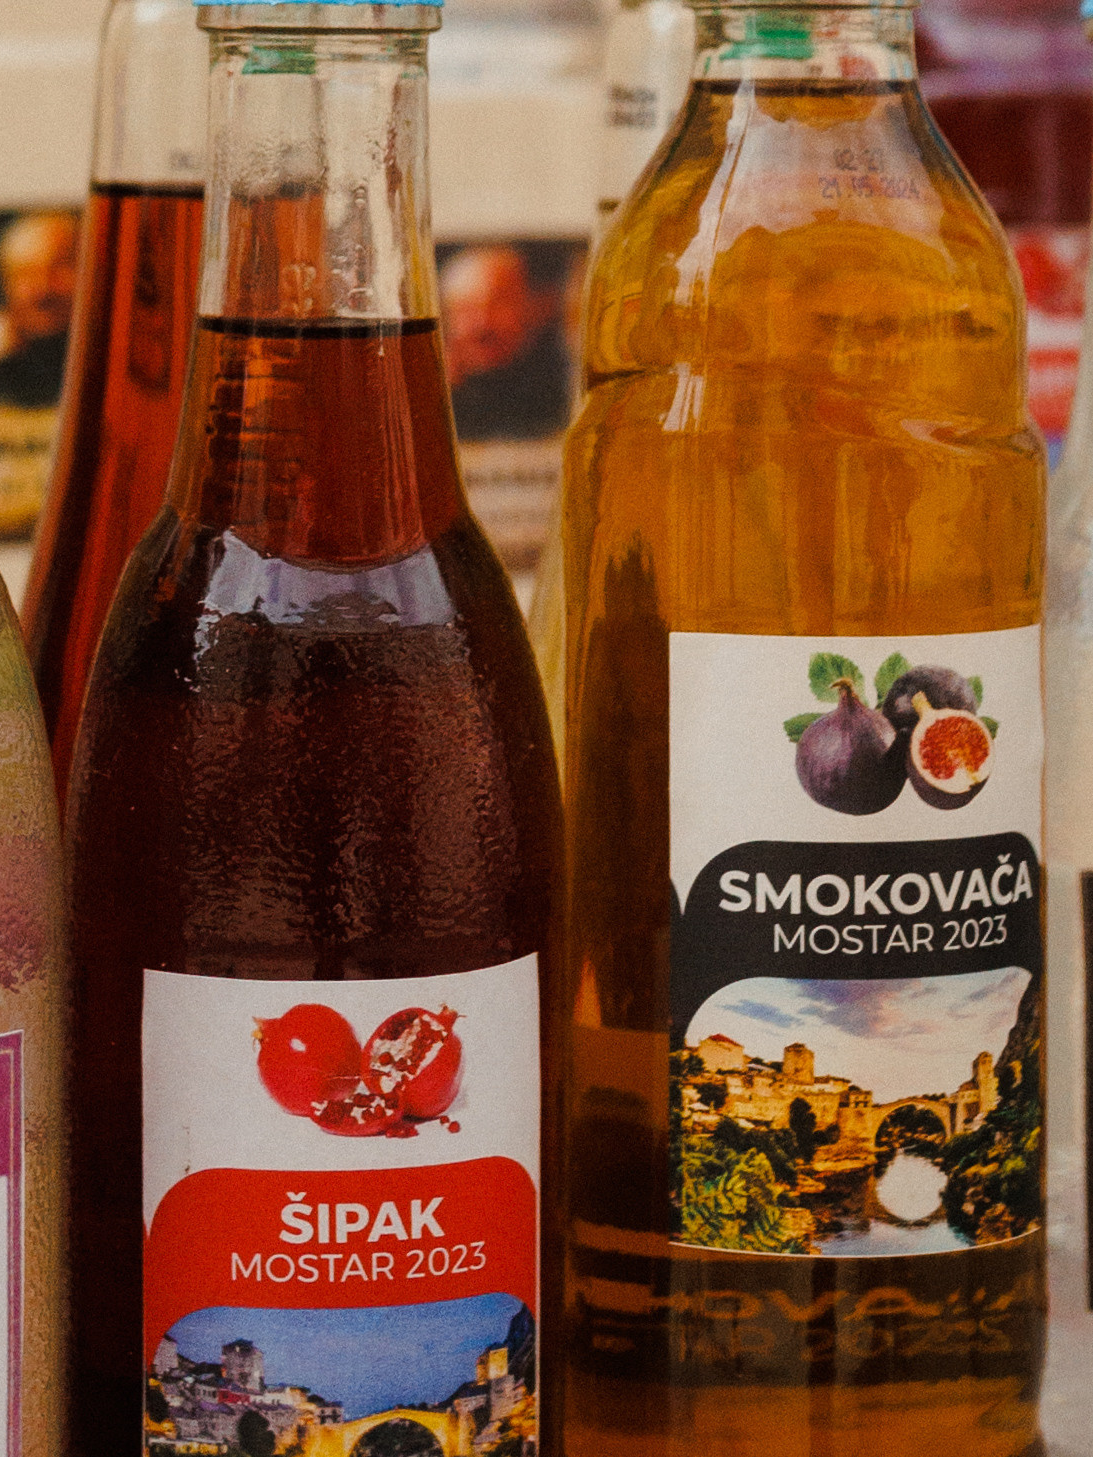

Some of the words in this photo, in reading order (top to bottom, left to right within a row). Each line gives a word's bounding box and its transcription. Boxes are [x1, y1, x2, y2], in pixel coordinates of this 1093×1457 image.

[718, 853, 1033, 917] SMOKOVAČA
[773, 921, 934, 955] MOSTAR
[942, 914, 1007, 952] 2023
[279, 1191, 445, 1244] ŠIPAK
[231, 1251, 395, 1283] MOSTAR
[406, 1241, 487, 1279] 2023
